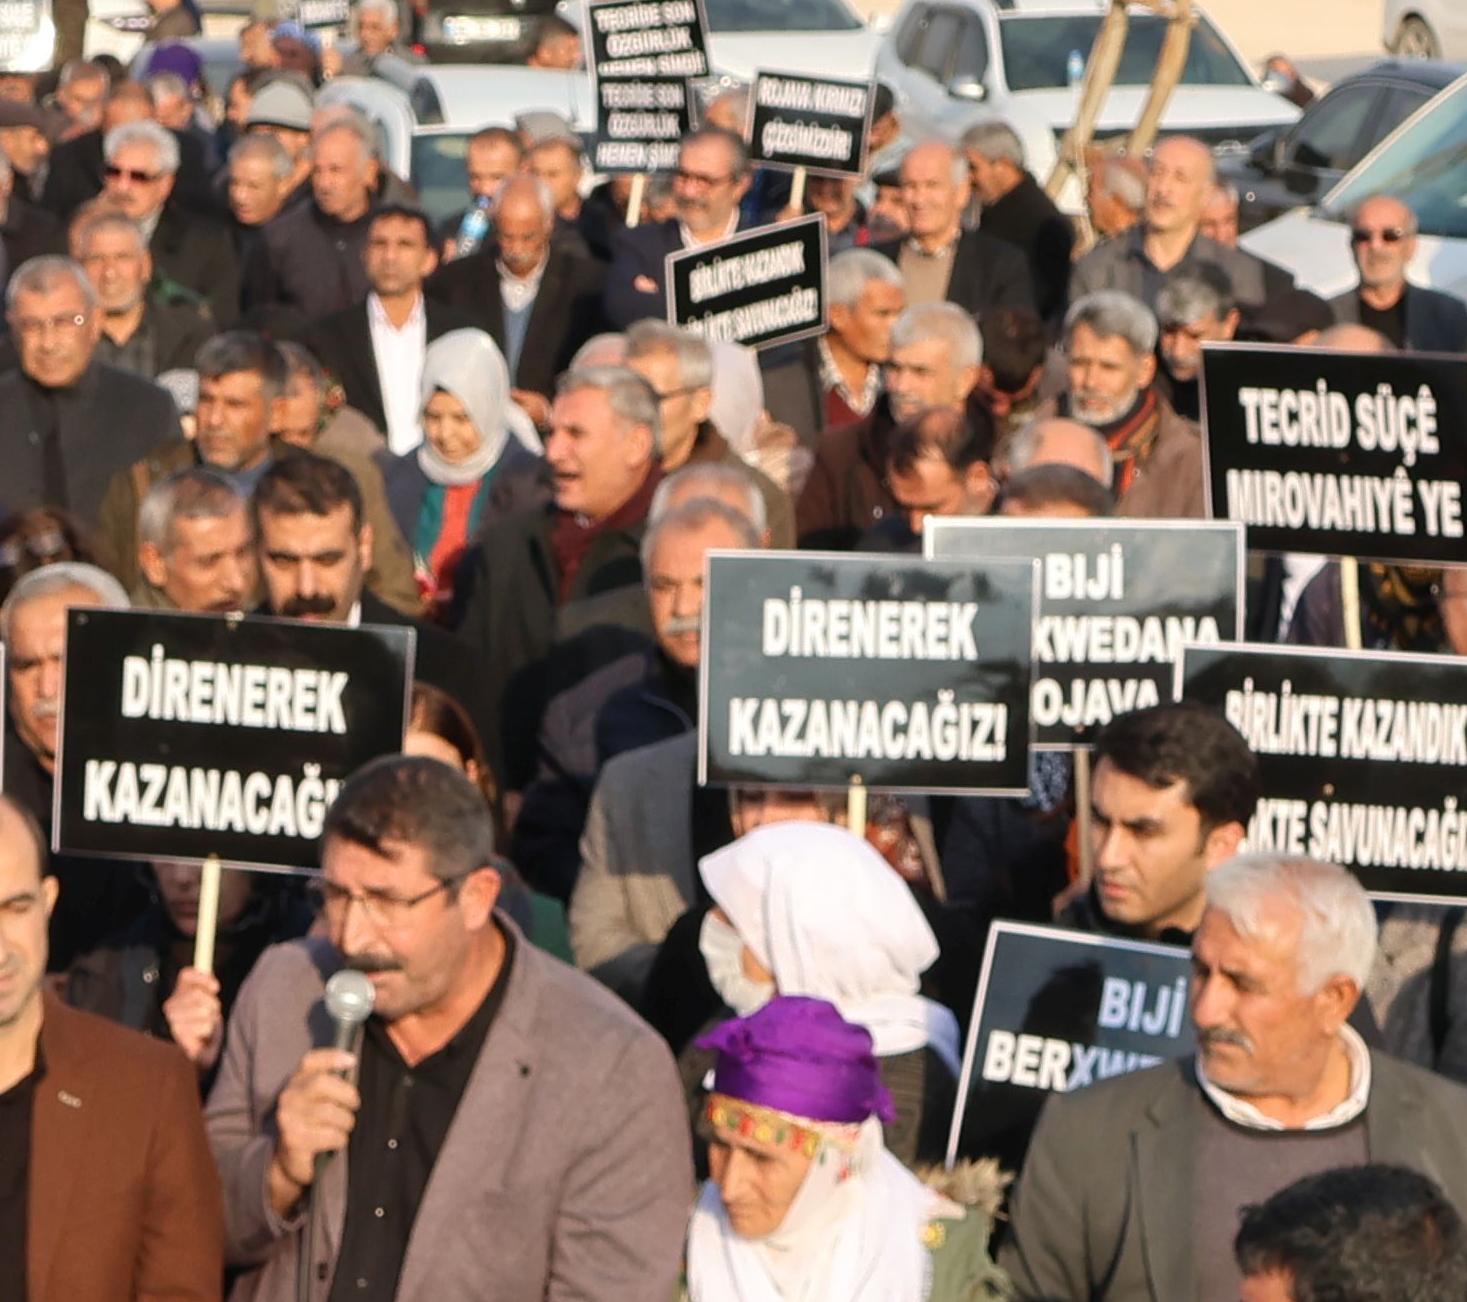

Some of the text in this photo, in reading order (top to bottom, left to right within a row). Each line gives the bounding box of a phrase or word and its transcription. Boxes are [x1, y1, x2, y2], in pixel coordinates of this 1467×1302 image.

[1238, 377, 1352, 448] TECRİD
[1417, 479, 1464, 539] YE
[1044, 541, 1125, 601] BIJİ
[762, 585, 979, 664] DİRENEREK
[119, 643, 350, 734] DİRENEREK
[1032, 677, 1160, 726] OJAVA
[727, 691, 1009, 764] KAZANACAĞIZ!
[1096, 974, 1187, 1038] BIJİ
